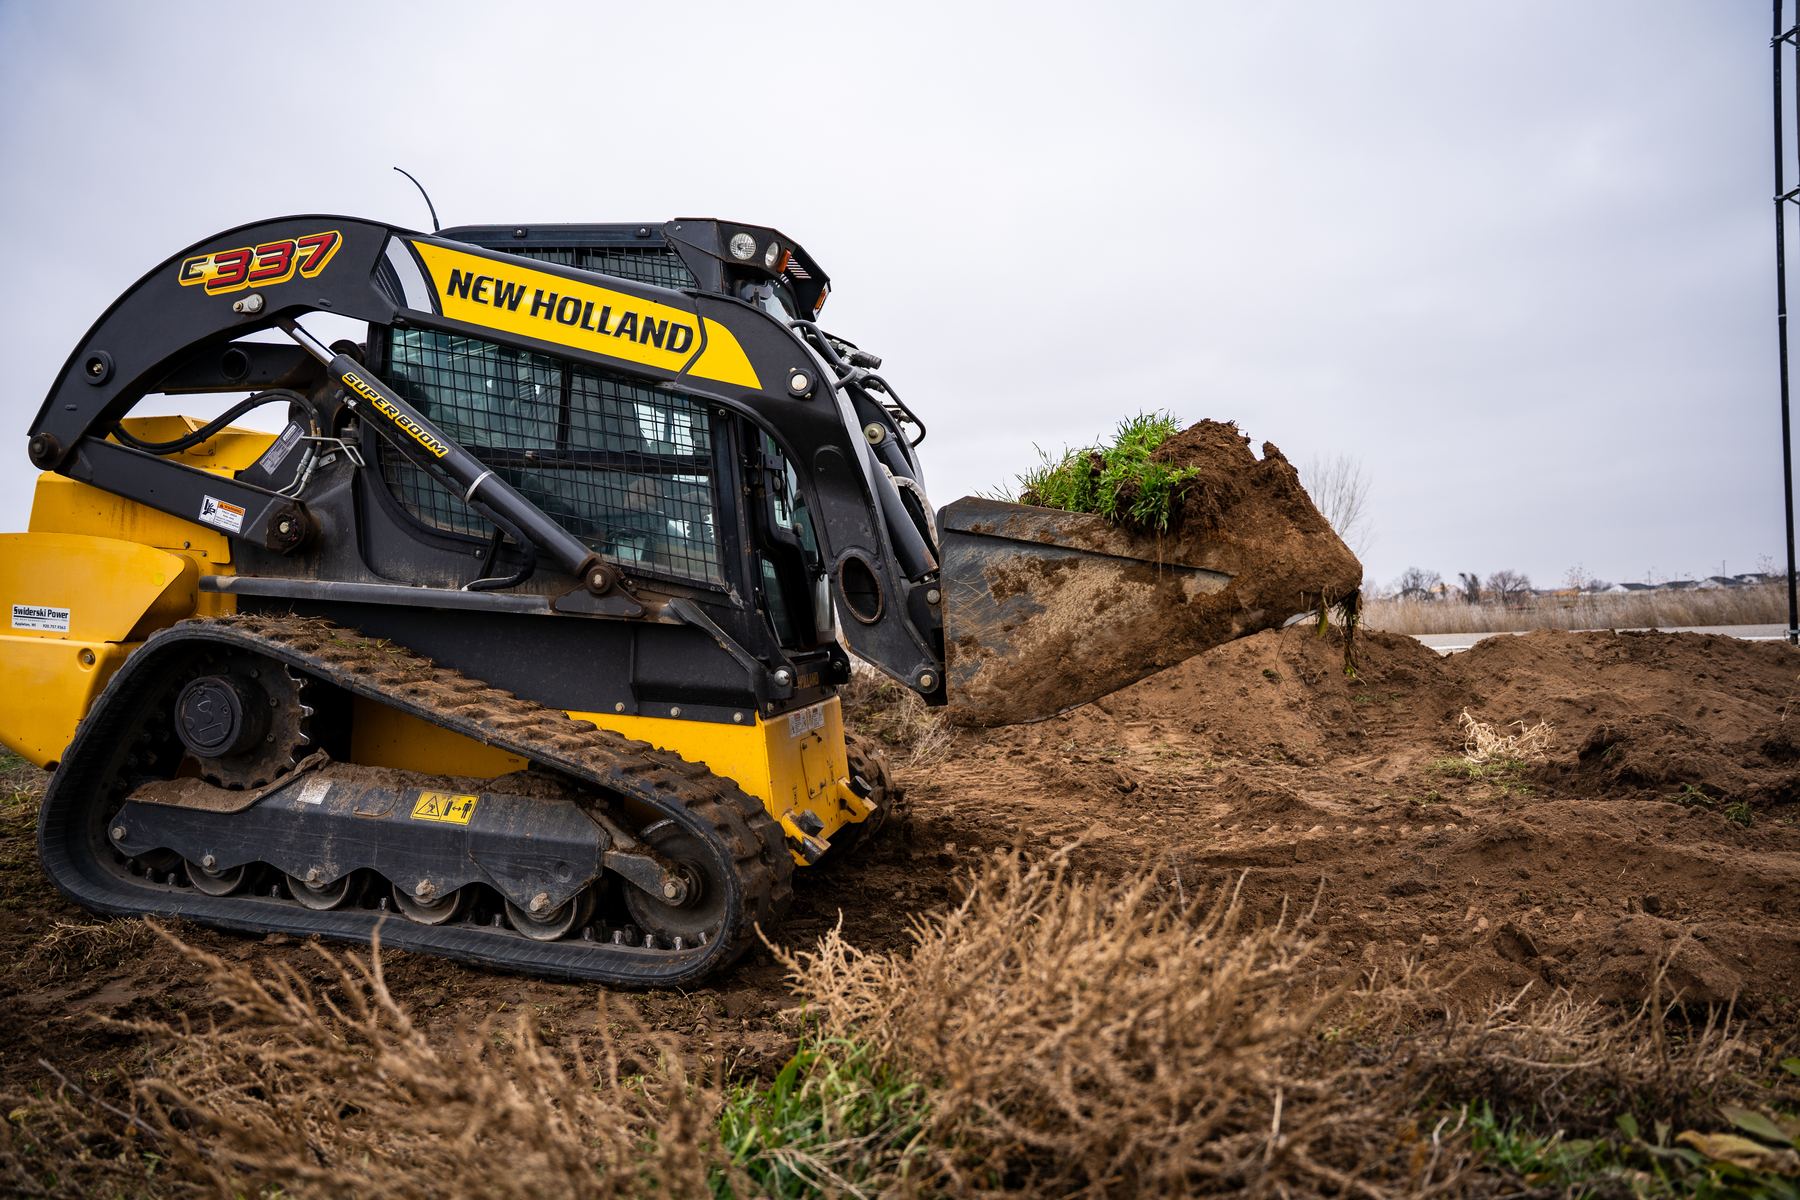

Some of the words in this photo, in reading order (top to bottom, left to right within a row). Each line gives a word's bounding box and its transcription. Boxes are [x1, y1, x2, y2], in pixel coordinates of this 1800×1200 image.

[447, 269, 527, 312] NEW
[529, 289, 694, 354] HOLLAND
[14, 606, 47, 617] Swiderski
[47, 609, 68, 619] Power
